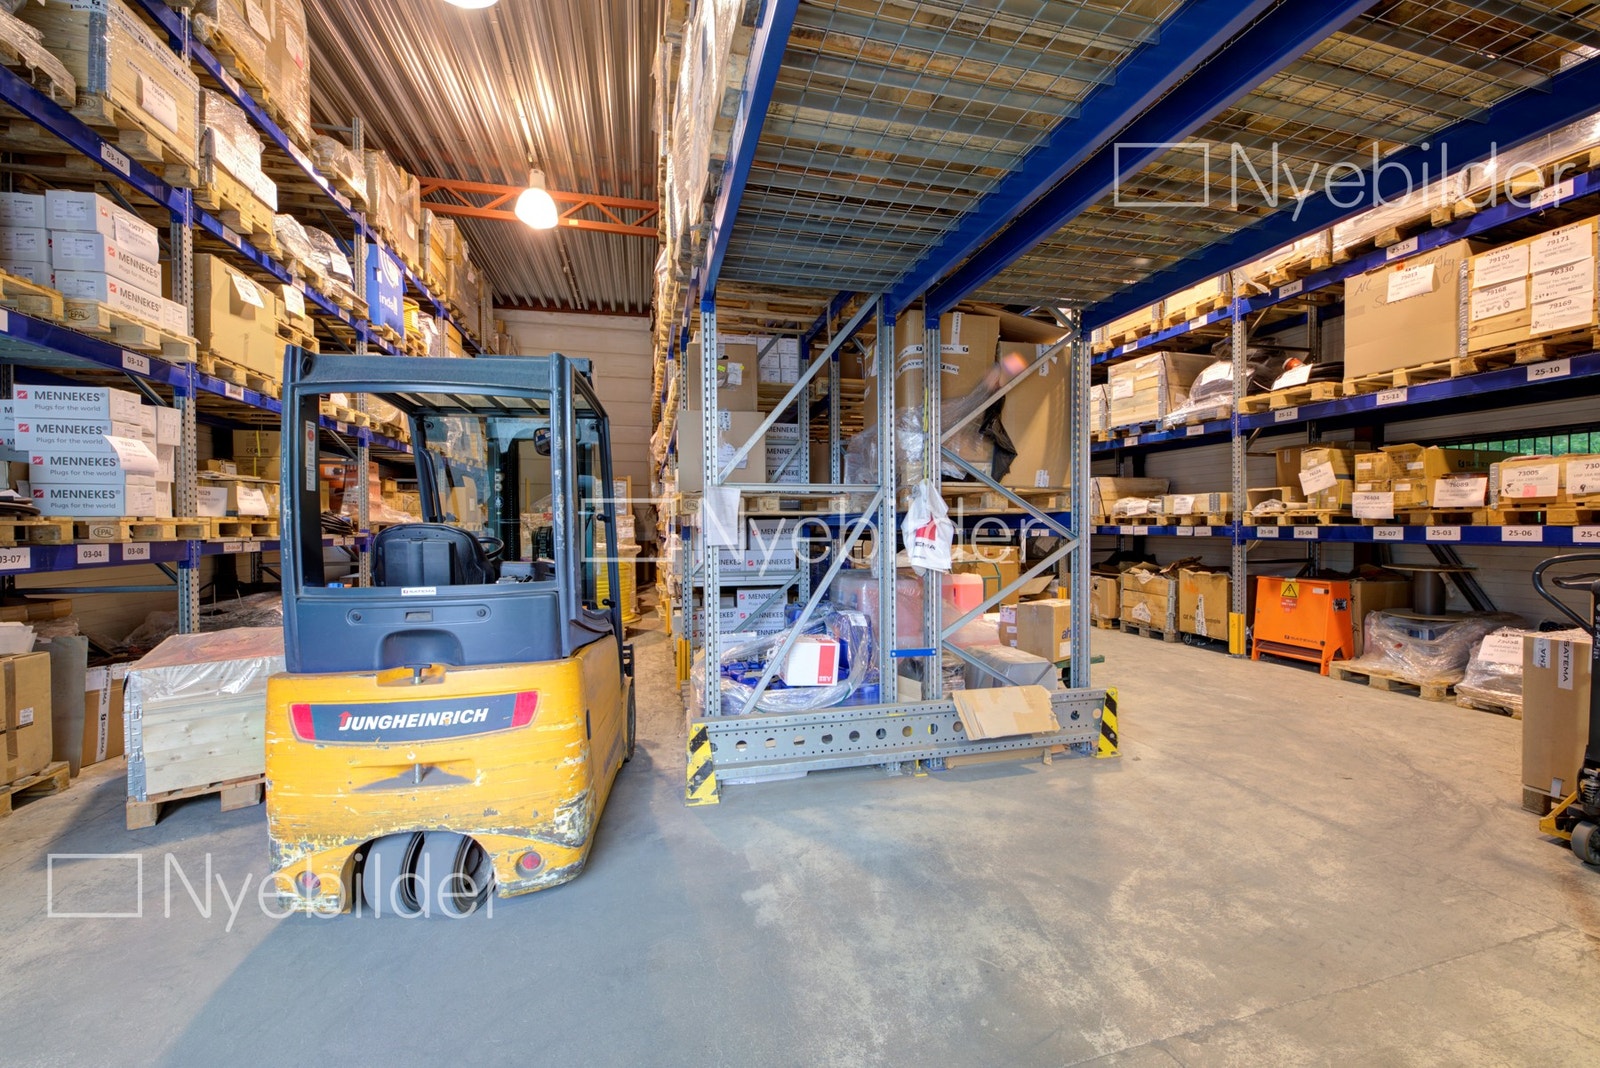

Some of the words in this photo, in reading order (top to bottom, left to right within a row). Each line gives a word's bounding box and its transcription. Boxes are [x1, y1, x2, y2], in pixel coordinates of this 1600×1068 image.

[1546, 236, 1570, 246] 79171
[1489, 254, 1510, 264] 79170
[1550, 266, 1574, 276] 76330
[1486, 287, 1506, 296] 79168
[1549, 300, 1572, 310] 79169
[127, 356, 144, 367] 03-12
[1535, 366, 1560, 376] 25-10
[338, 708, 489, 731] JUNGHEINRICH
